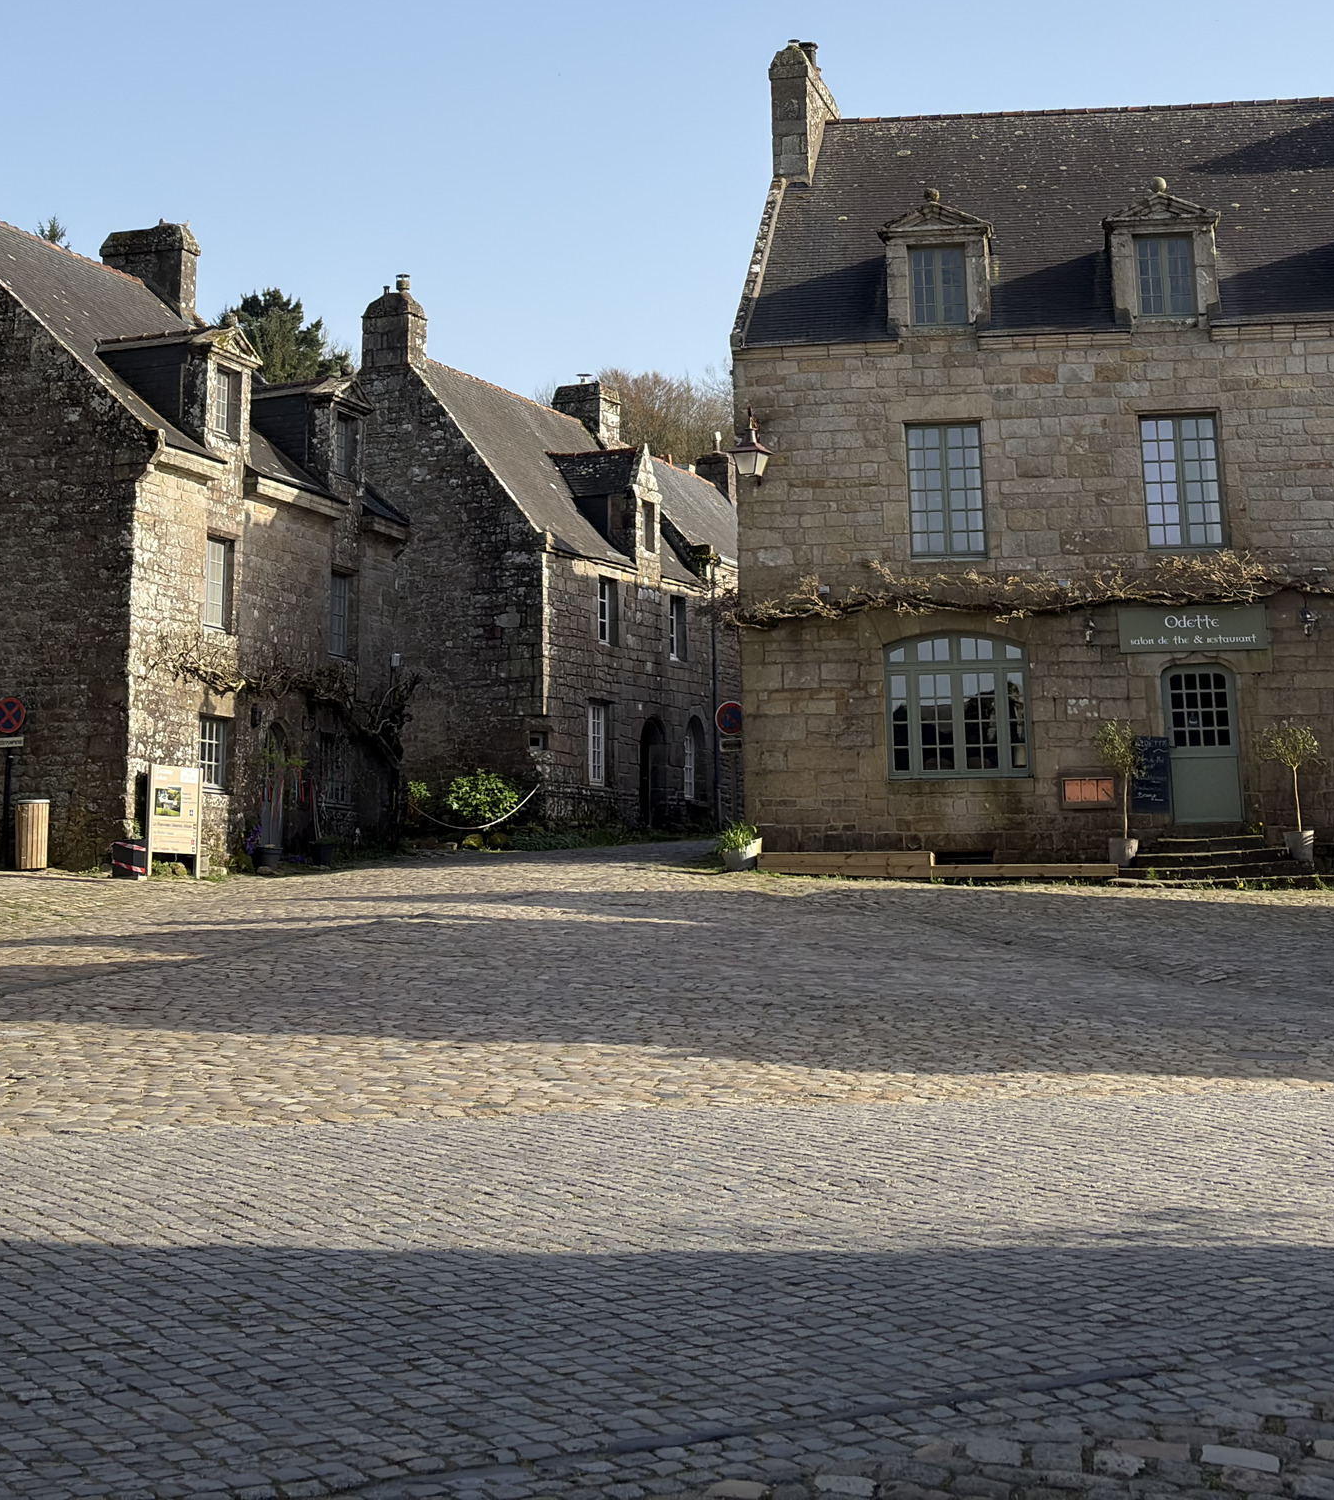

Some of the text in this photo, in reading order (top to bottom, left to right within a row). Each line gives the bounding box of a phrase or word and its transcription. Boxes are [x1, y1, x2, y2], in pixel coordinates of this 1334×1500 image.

[1164, 614, 1220, 630] Odette
[1130, 636, 1155, 646] salon
[1158, 636, 1169, 644] de
[1193, 635, 1203, 644] &
[1207, 633, 1257, 644] restaurant
